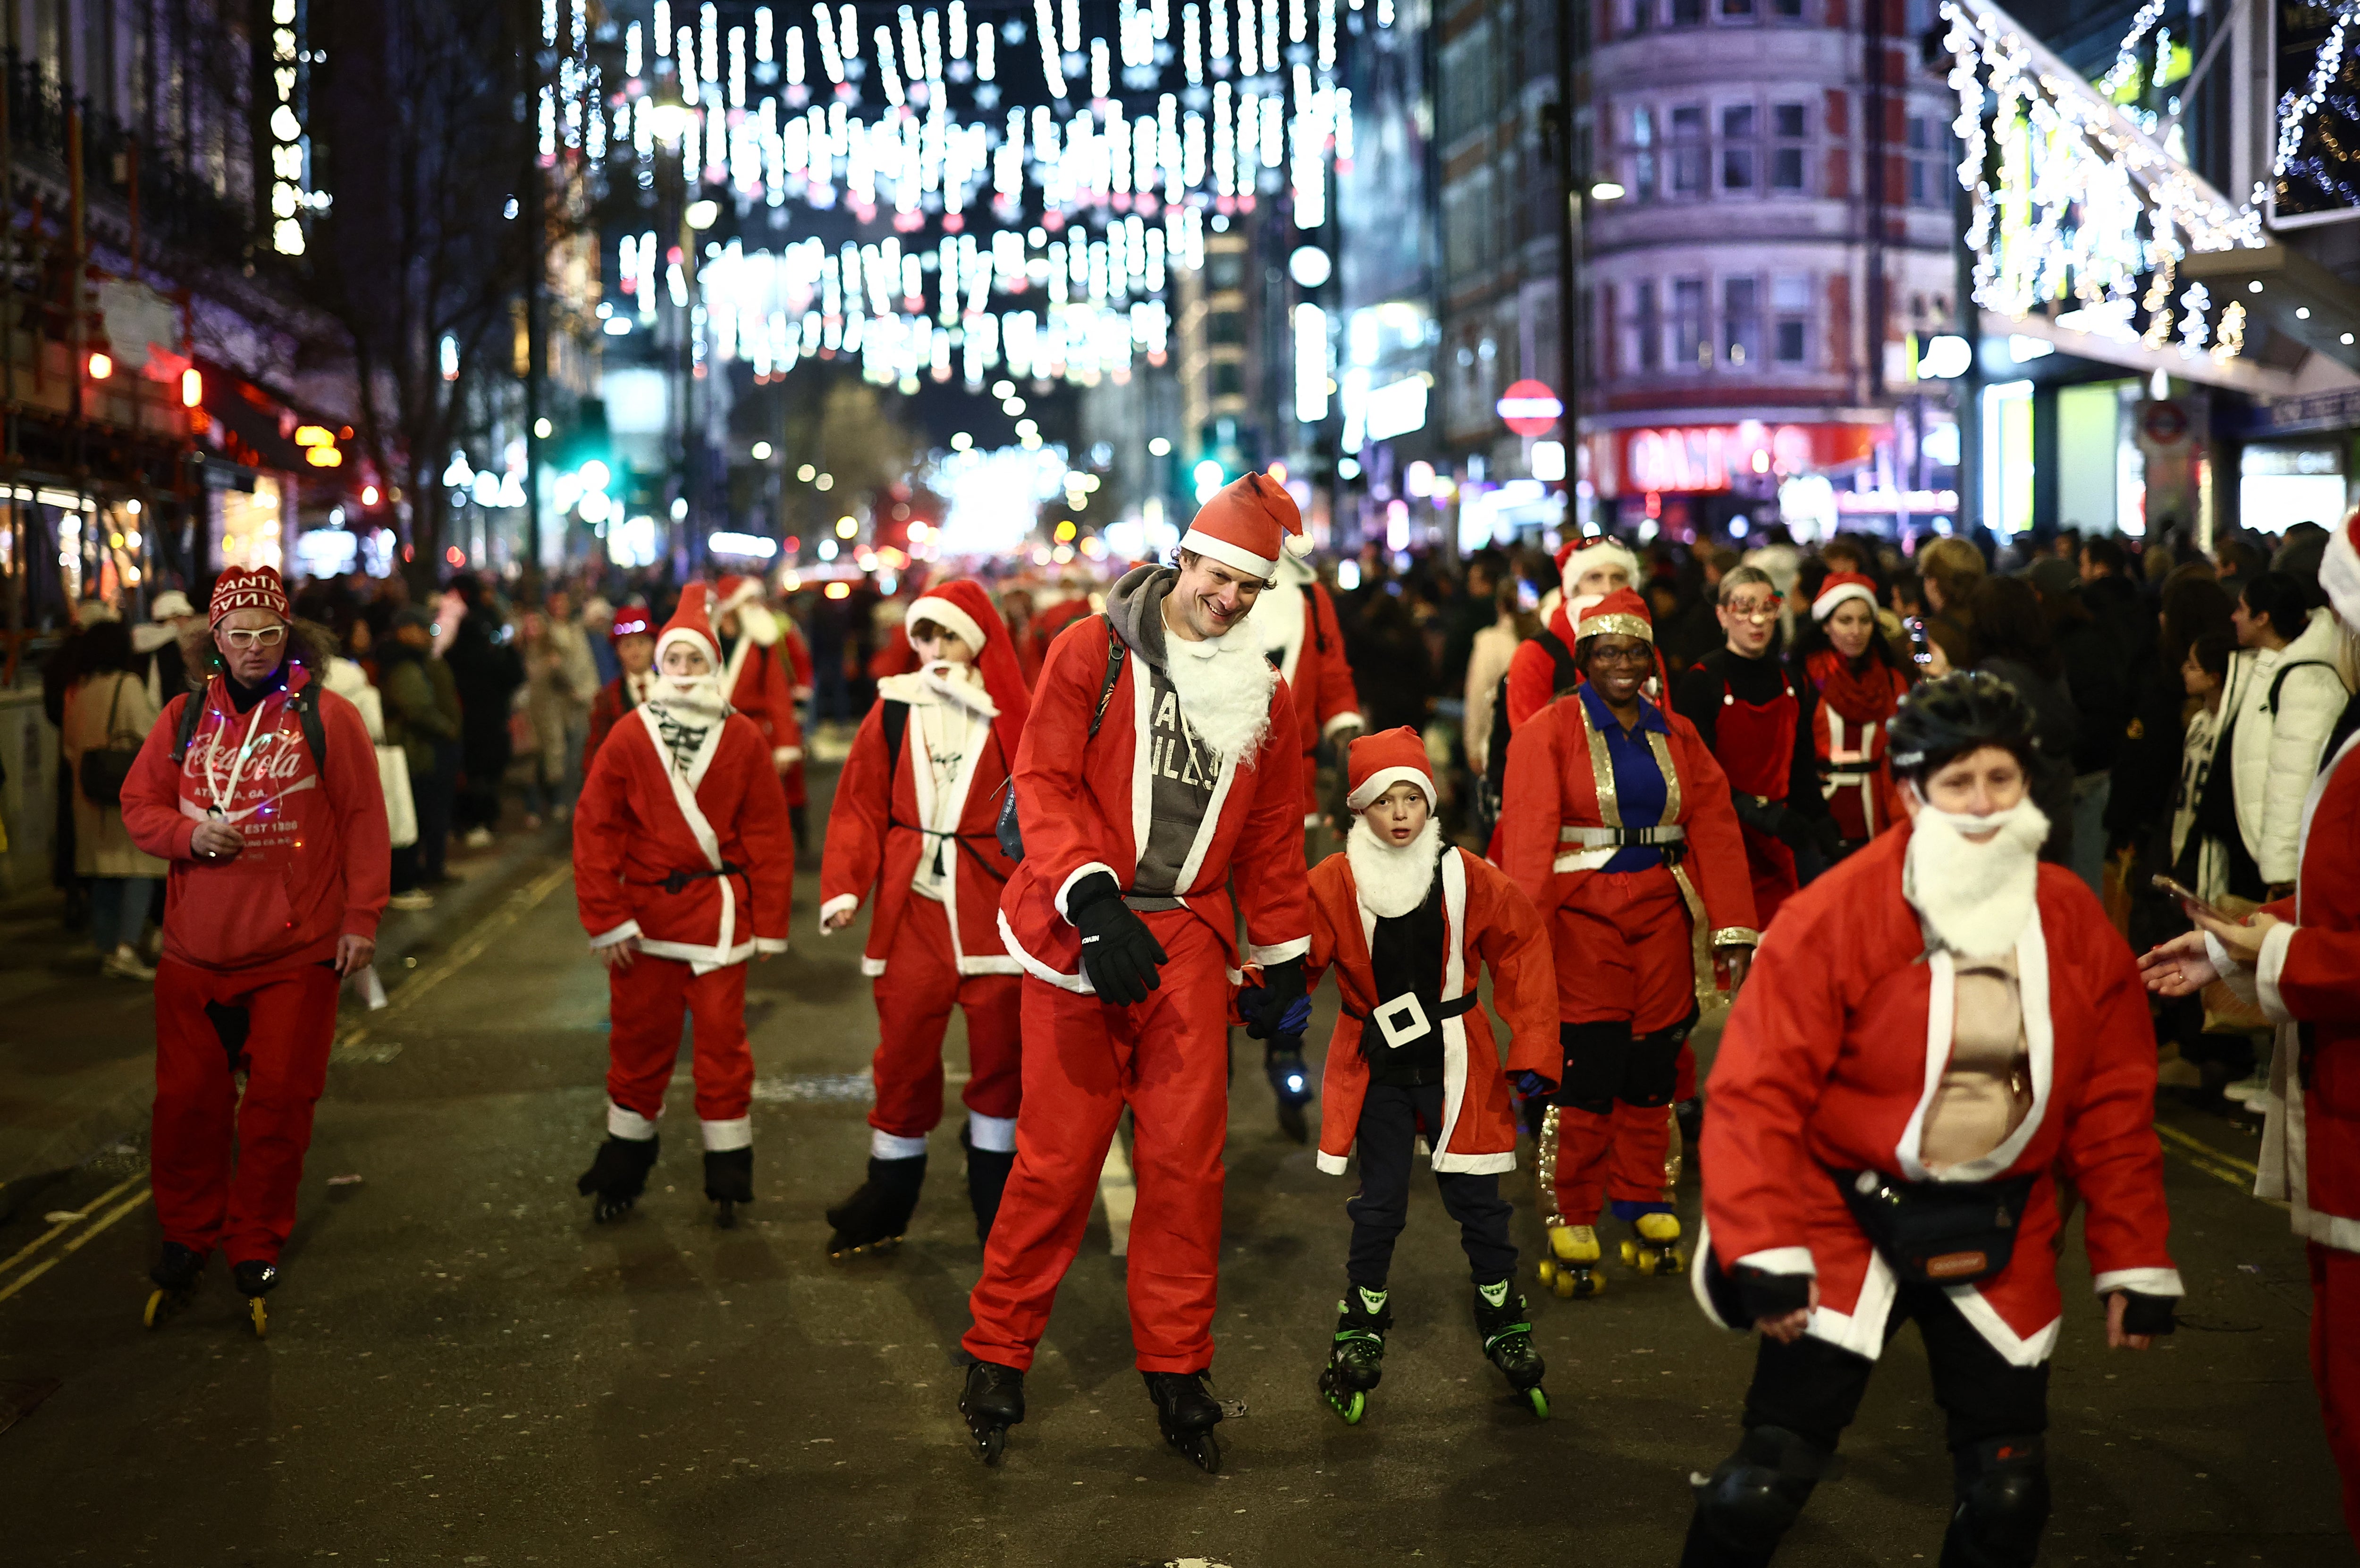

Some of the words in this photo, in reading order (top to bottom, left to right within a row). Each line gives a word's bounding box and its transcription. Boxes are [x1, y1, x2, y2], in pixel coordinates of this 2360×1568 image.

[212, 575, 282, 598] SANTA
[184, 731, 304, 782] CocaCola
[244, 823, 268, 835] EST
